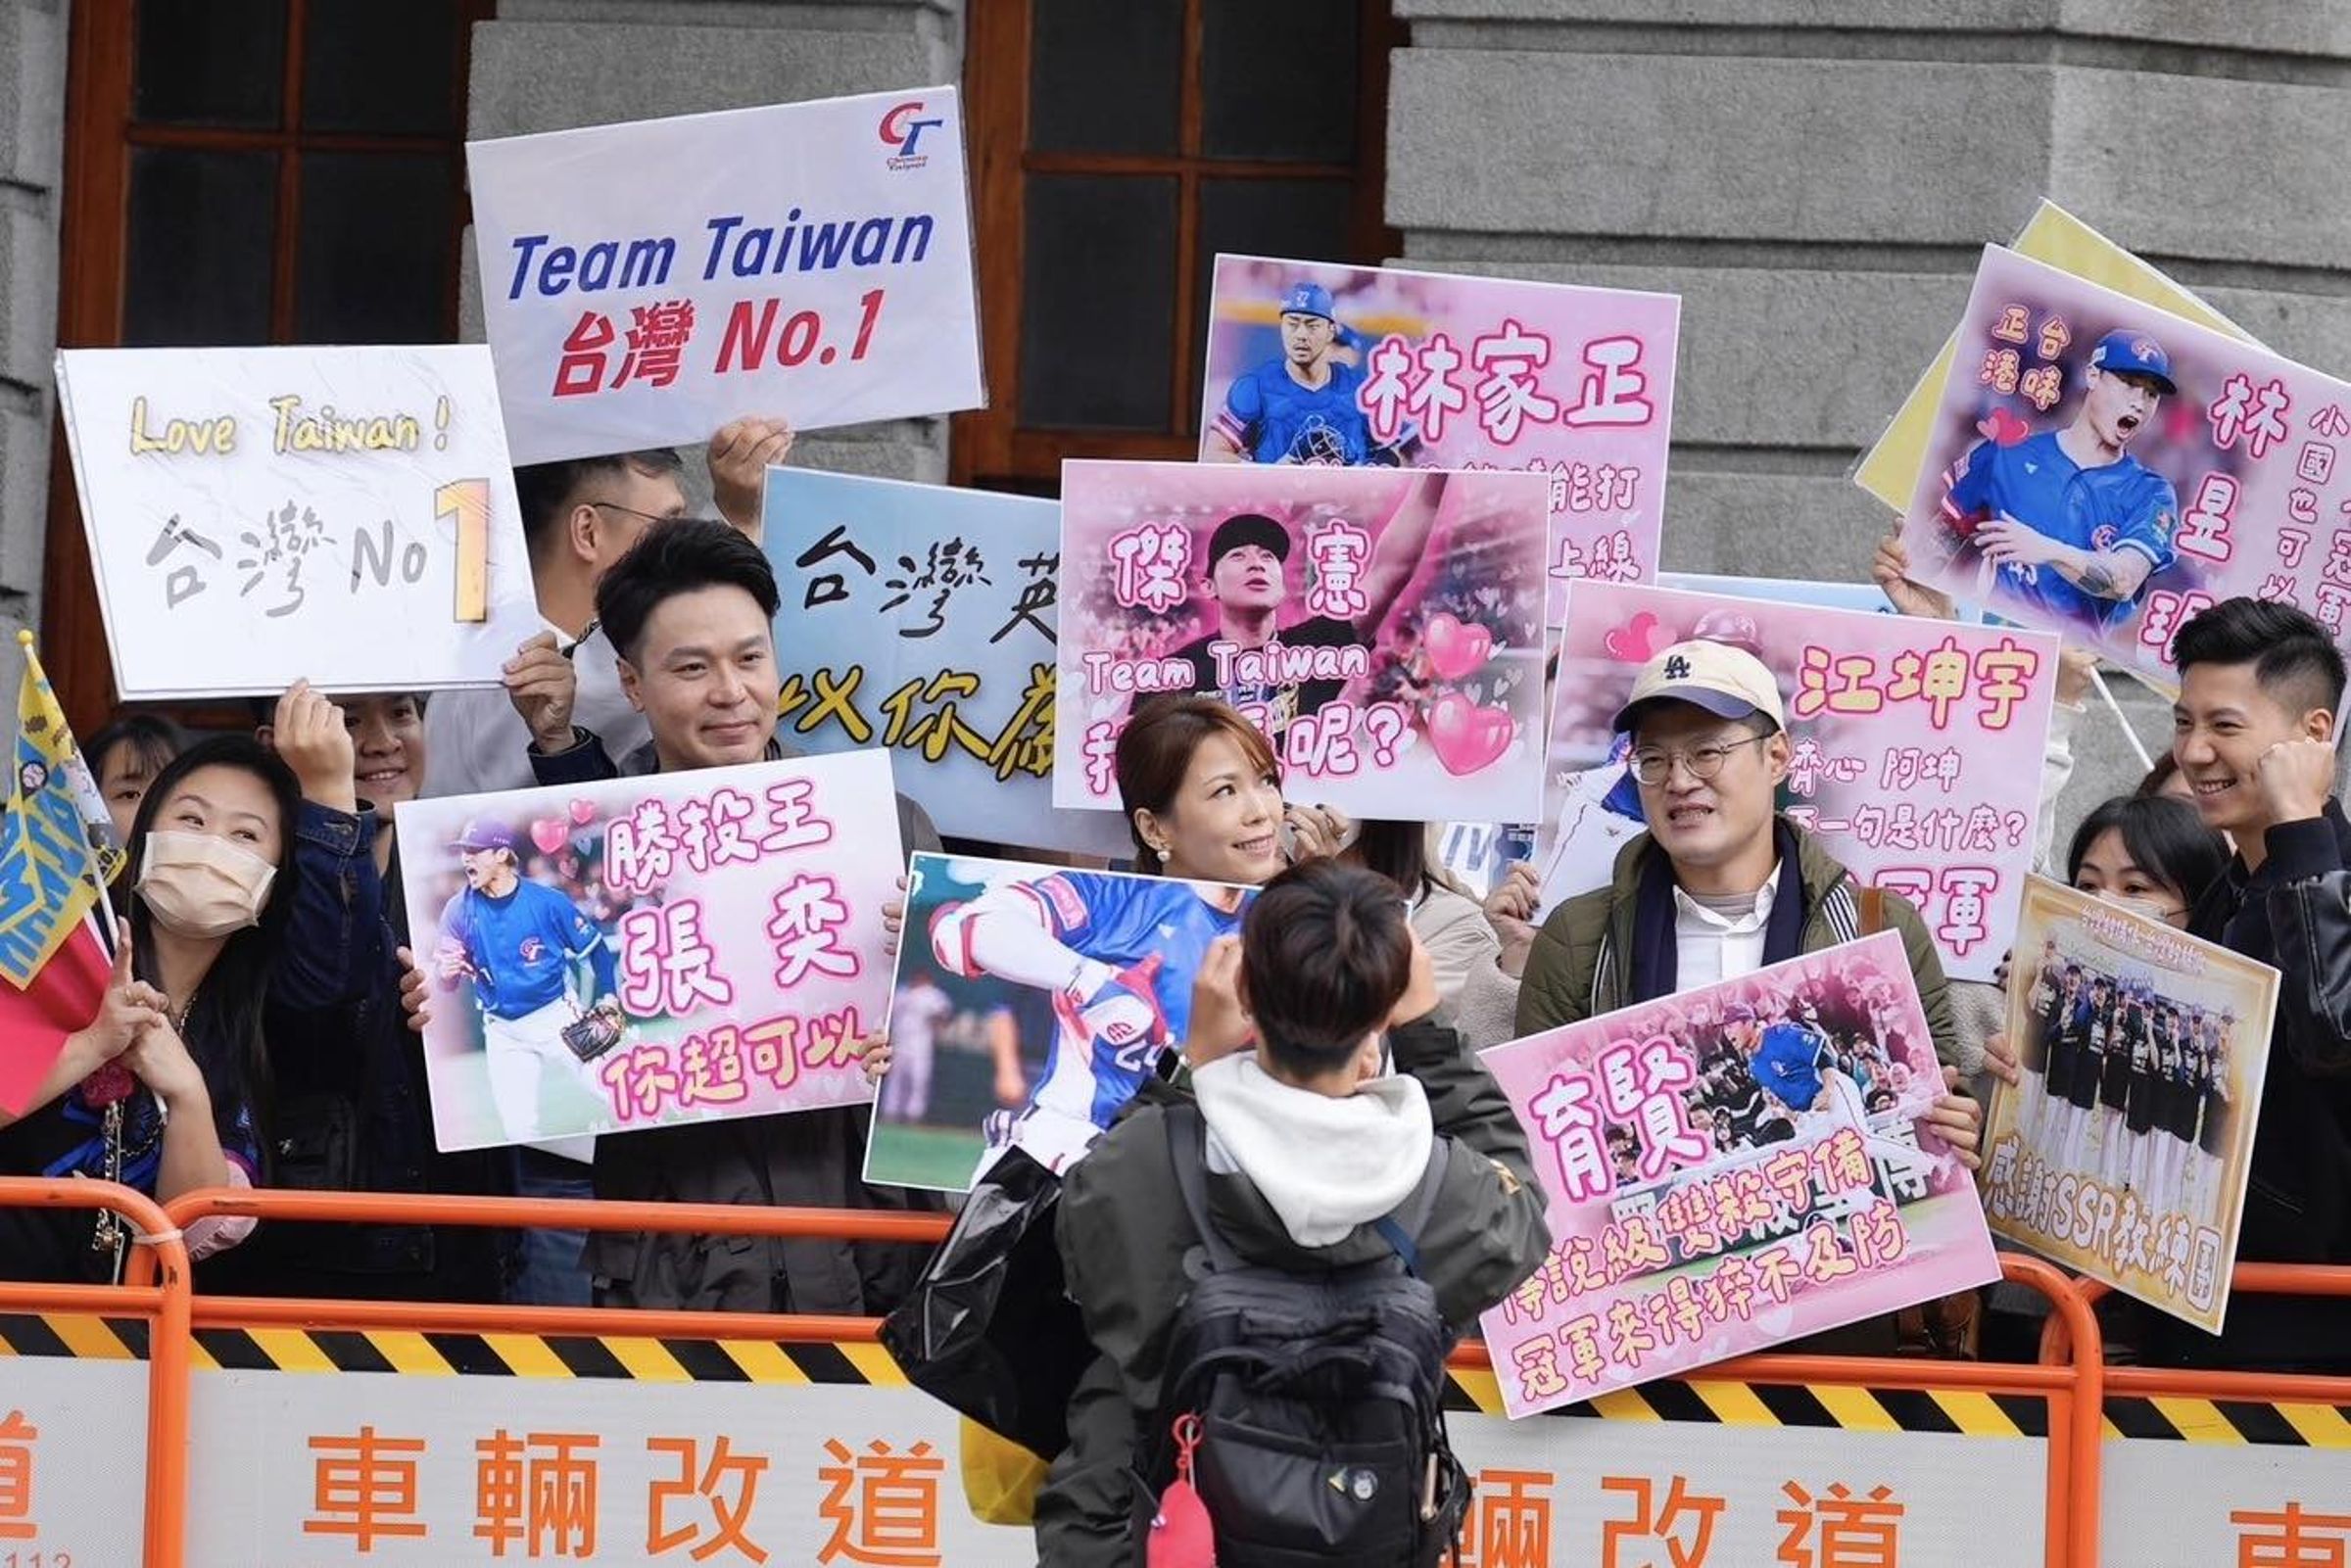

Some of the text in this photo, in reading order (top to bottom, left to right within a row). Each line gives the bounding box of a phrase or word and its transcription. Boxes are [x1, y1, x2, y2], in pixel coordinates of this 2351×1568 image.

[508, 208, 934, 300] Team Taiwan
[552, 289, 885, 396] 台灣 No.1
[1362, 318, 1653, 445] 林家正
[130, 396, 237, 455] Love
[146, 499, 337, 618] 台灣
[1084, 642, 1368, 693] Team Taiwan
[1664, 655, 1692, 680] LA
[1796, 636, 2038, 730] 江坤宇
[1880, 746, 1960, 792] 阿坤
[606, 780, 832, 893] 勝投王
[602, 1007, 868, 1120] 你超可以
[1530, 1040, 1706, 1202] 育賢
[1511, 1201, 1907, 1402] 冠軍來得猝不及防
[303, 1426, 944, 1567] 車輛改道
